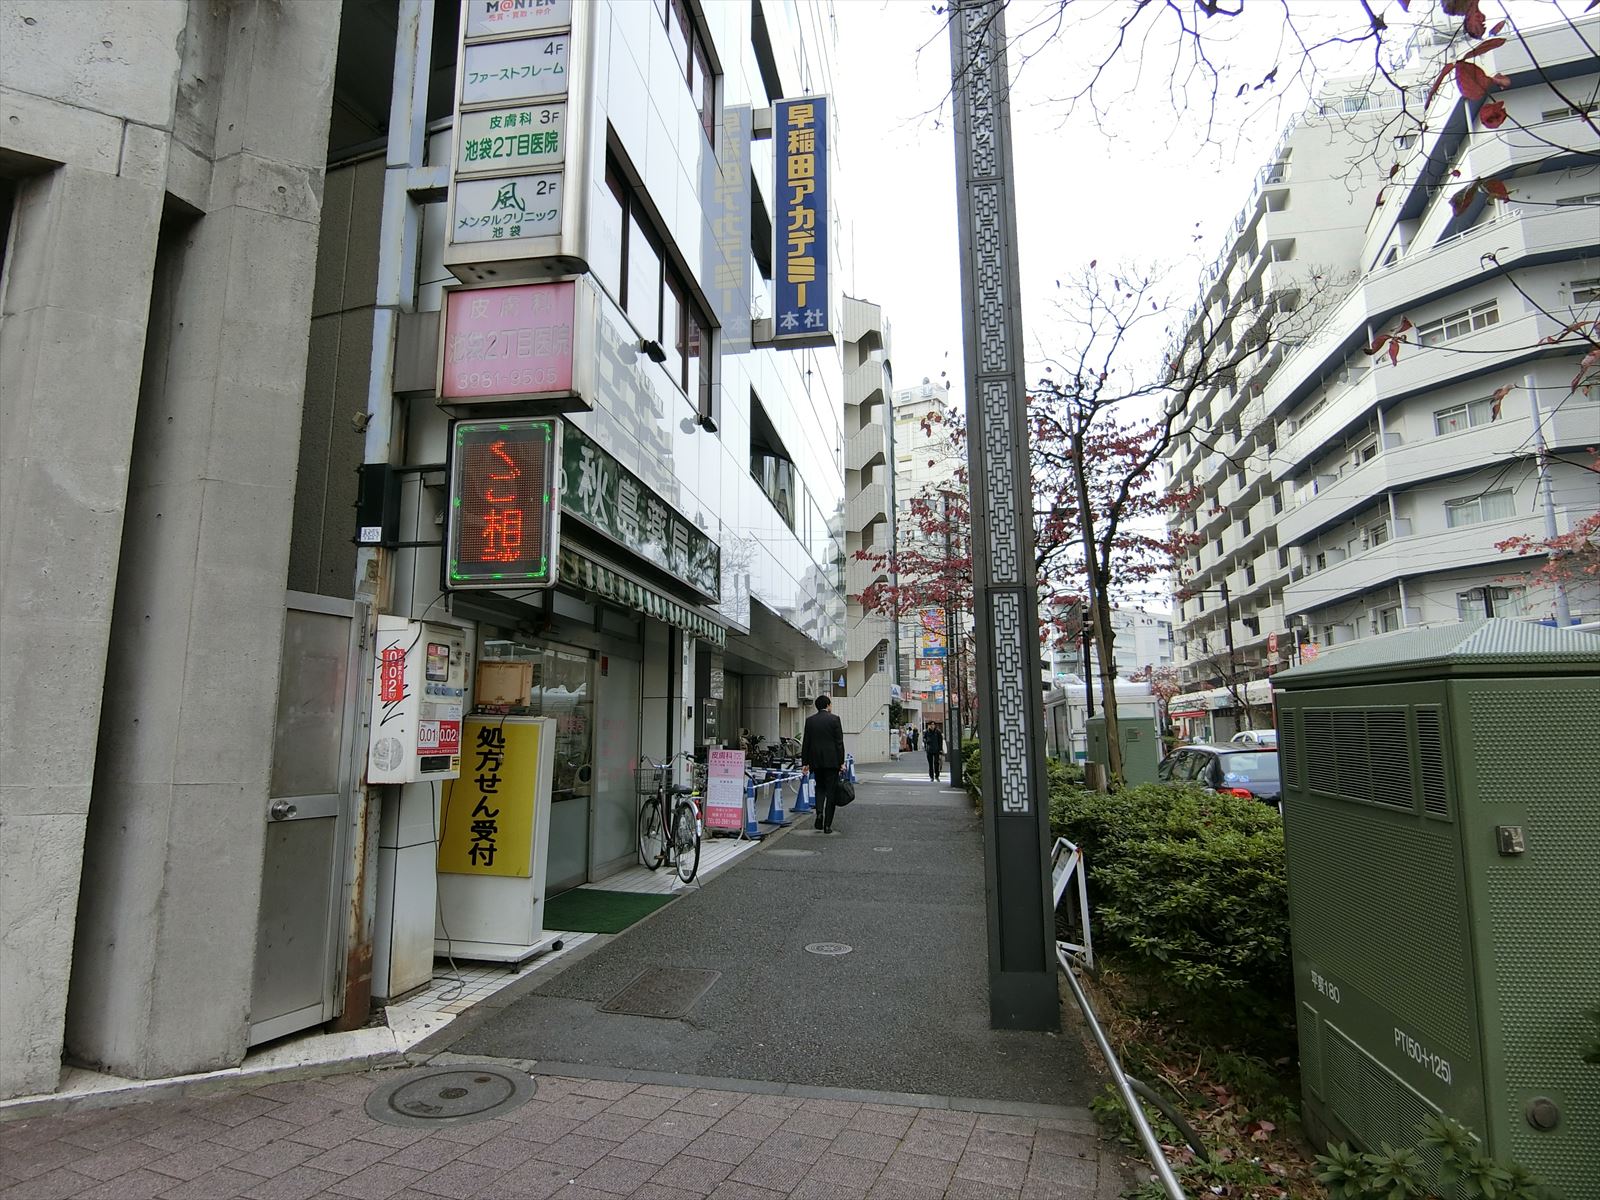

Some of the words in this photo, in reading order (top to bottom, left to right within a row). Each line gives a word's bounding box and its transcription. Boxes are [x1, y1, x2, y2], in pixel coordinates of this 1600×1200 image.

[544, 42, 563, 55] 4F
[469, 62, 564, 85] ファーストフレーム
[489, 112, 532, 129] 皮膚科
[540, 110, 560, 124] 3F
[465, 130, 559, 162] 池袋2丁目医院
[536, 181, 557, 195] 2F
[787, 103, 815, 308] 早稲田アカデミー
[458, 209, 558, 229] メンタルクリニック
[492, 225, 521, 238] 池袋
[780, 309, 824, 330] 本社
[419, 728, 436, 742] 0.01
[440, 728, 456, 742] 0.02
[467, 726, 506, 867] 処方せん受付
